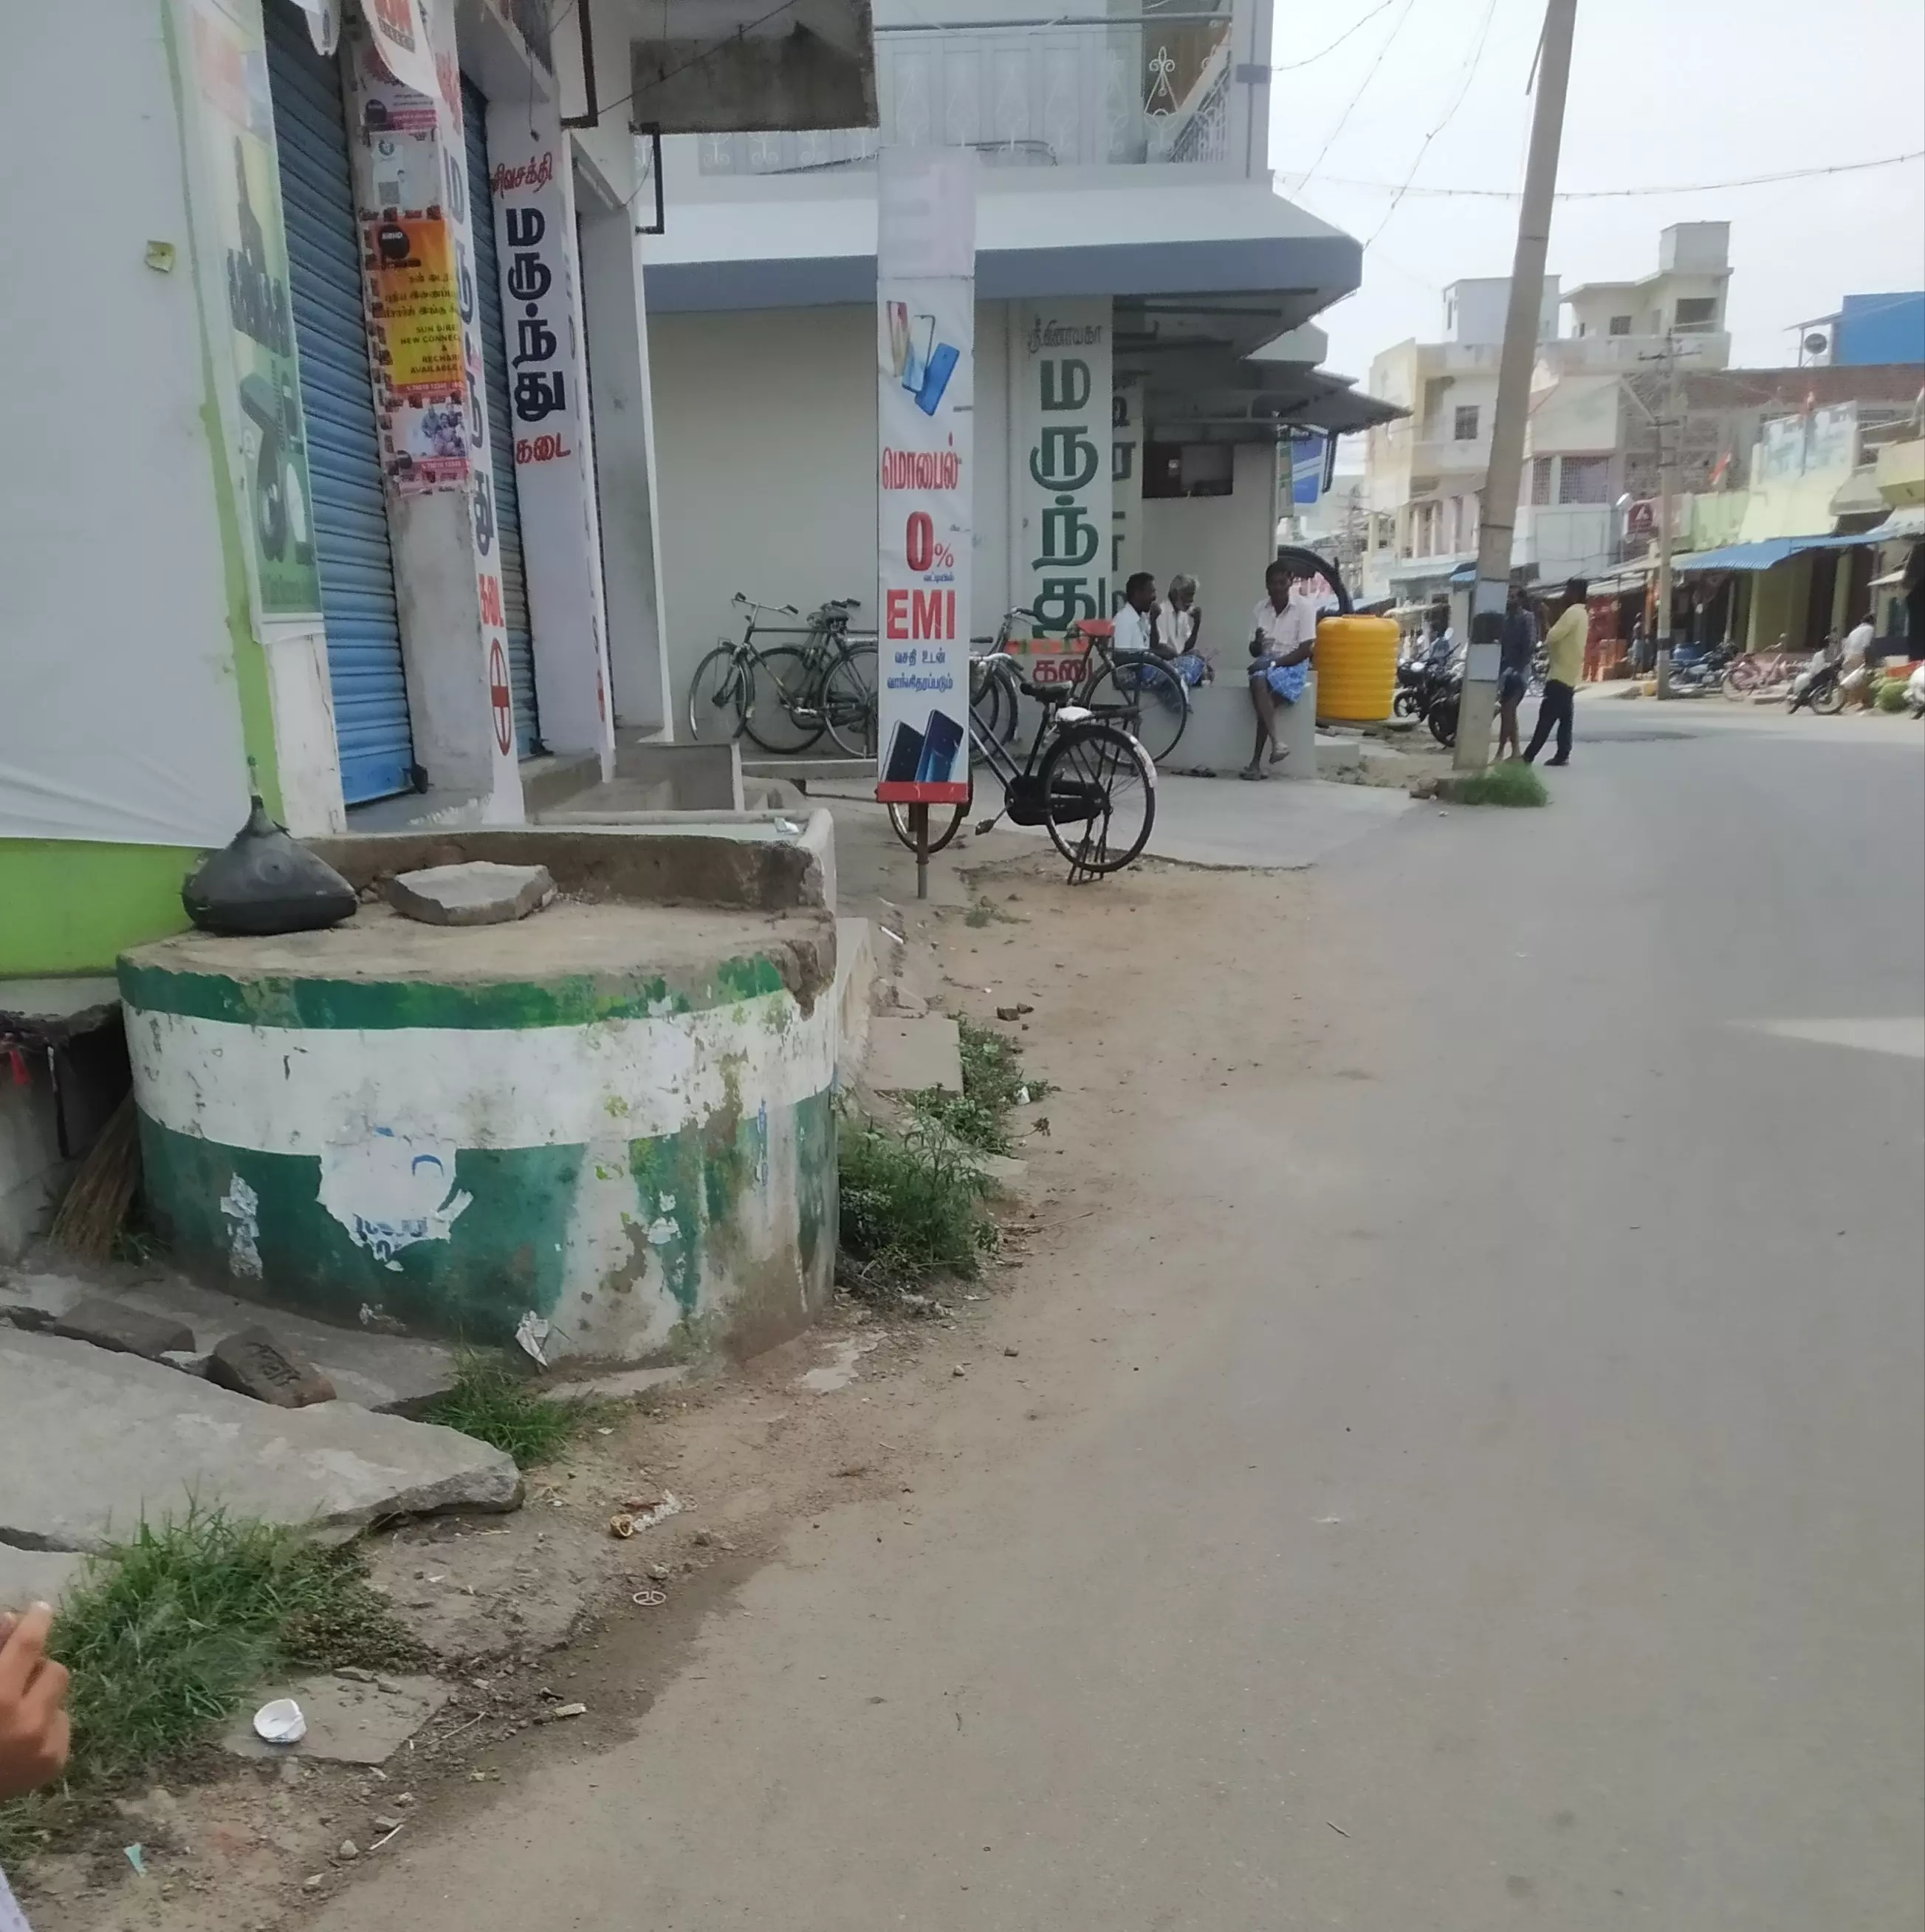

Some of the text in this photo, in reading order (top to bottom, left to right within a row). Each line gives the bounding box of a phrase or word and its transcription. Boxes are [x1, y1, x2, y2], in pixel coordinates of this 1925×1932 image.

[505, 208, 566, 422] மருந்து
[516, 433, 571, 465] கடை
[882, 431, 958, 490] மொபைல்
[906, 511, 954, 572] 0%
[887, 589, 955, 640] EMI
